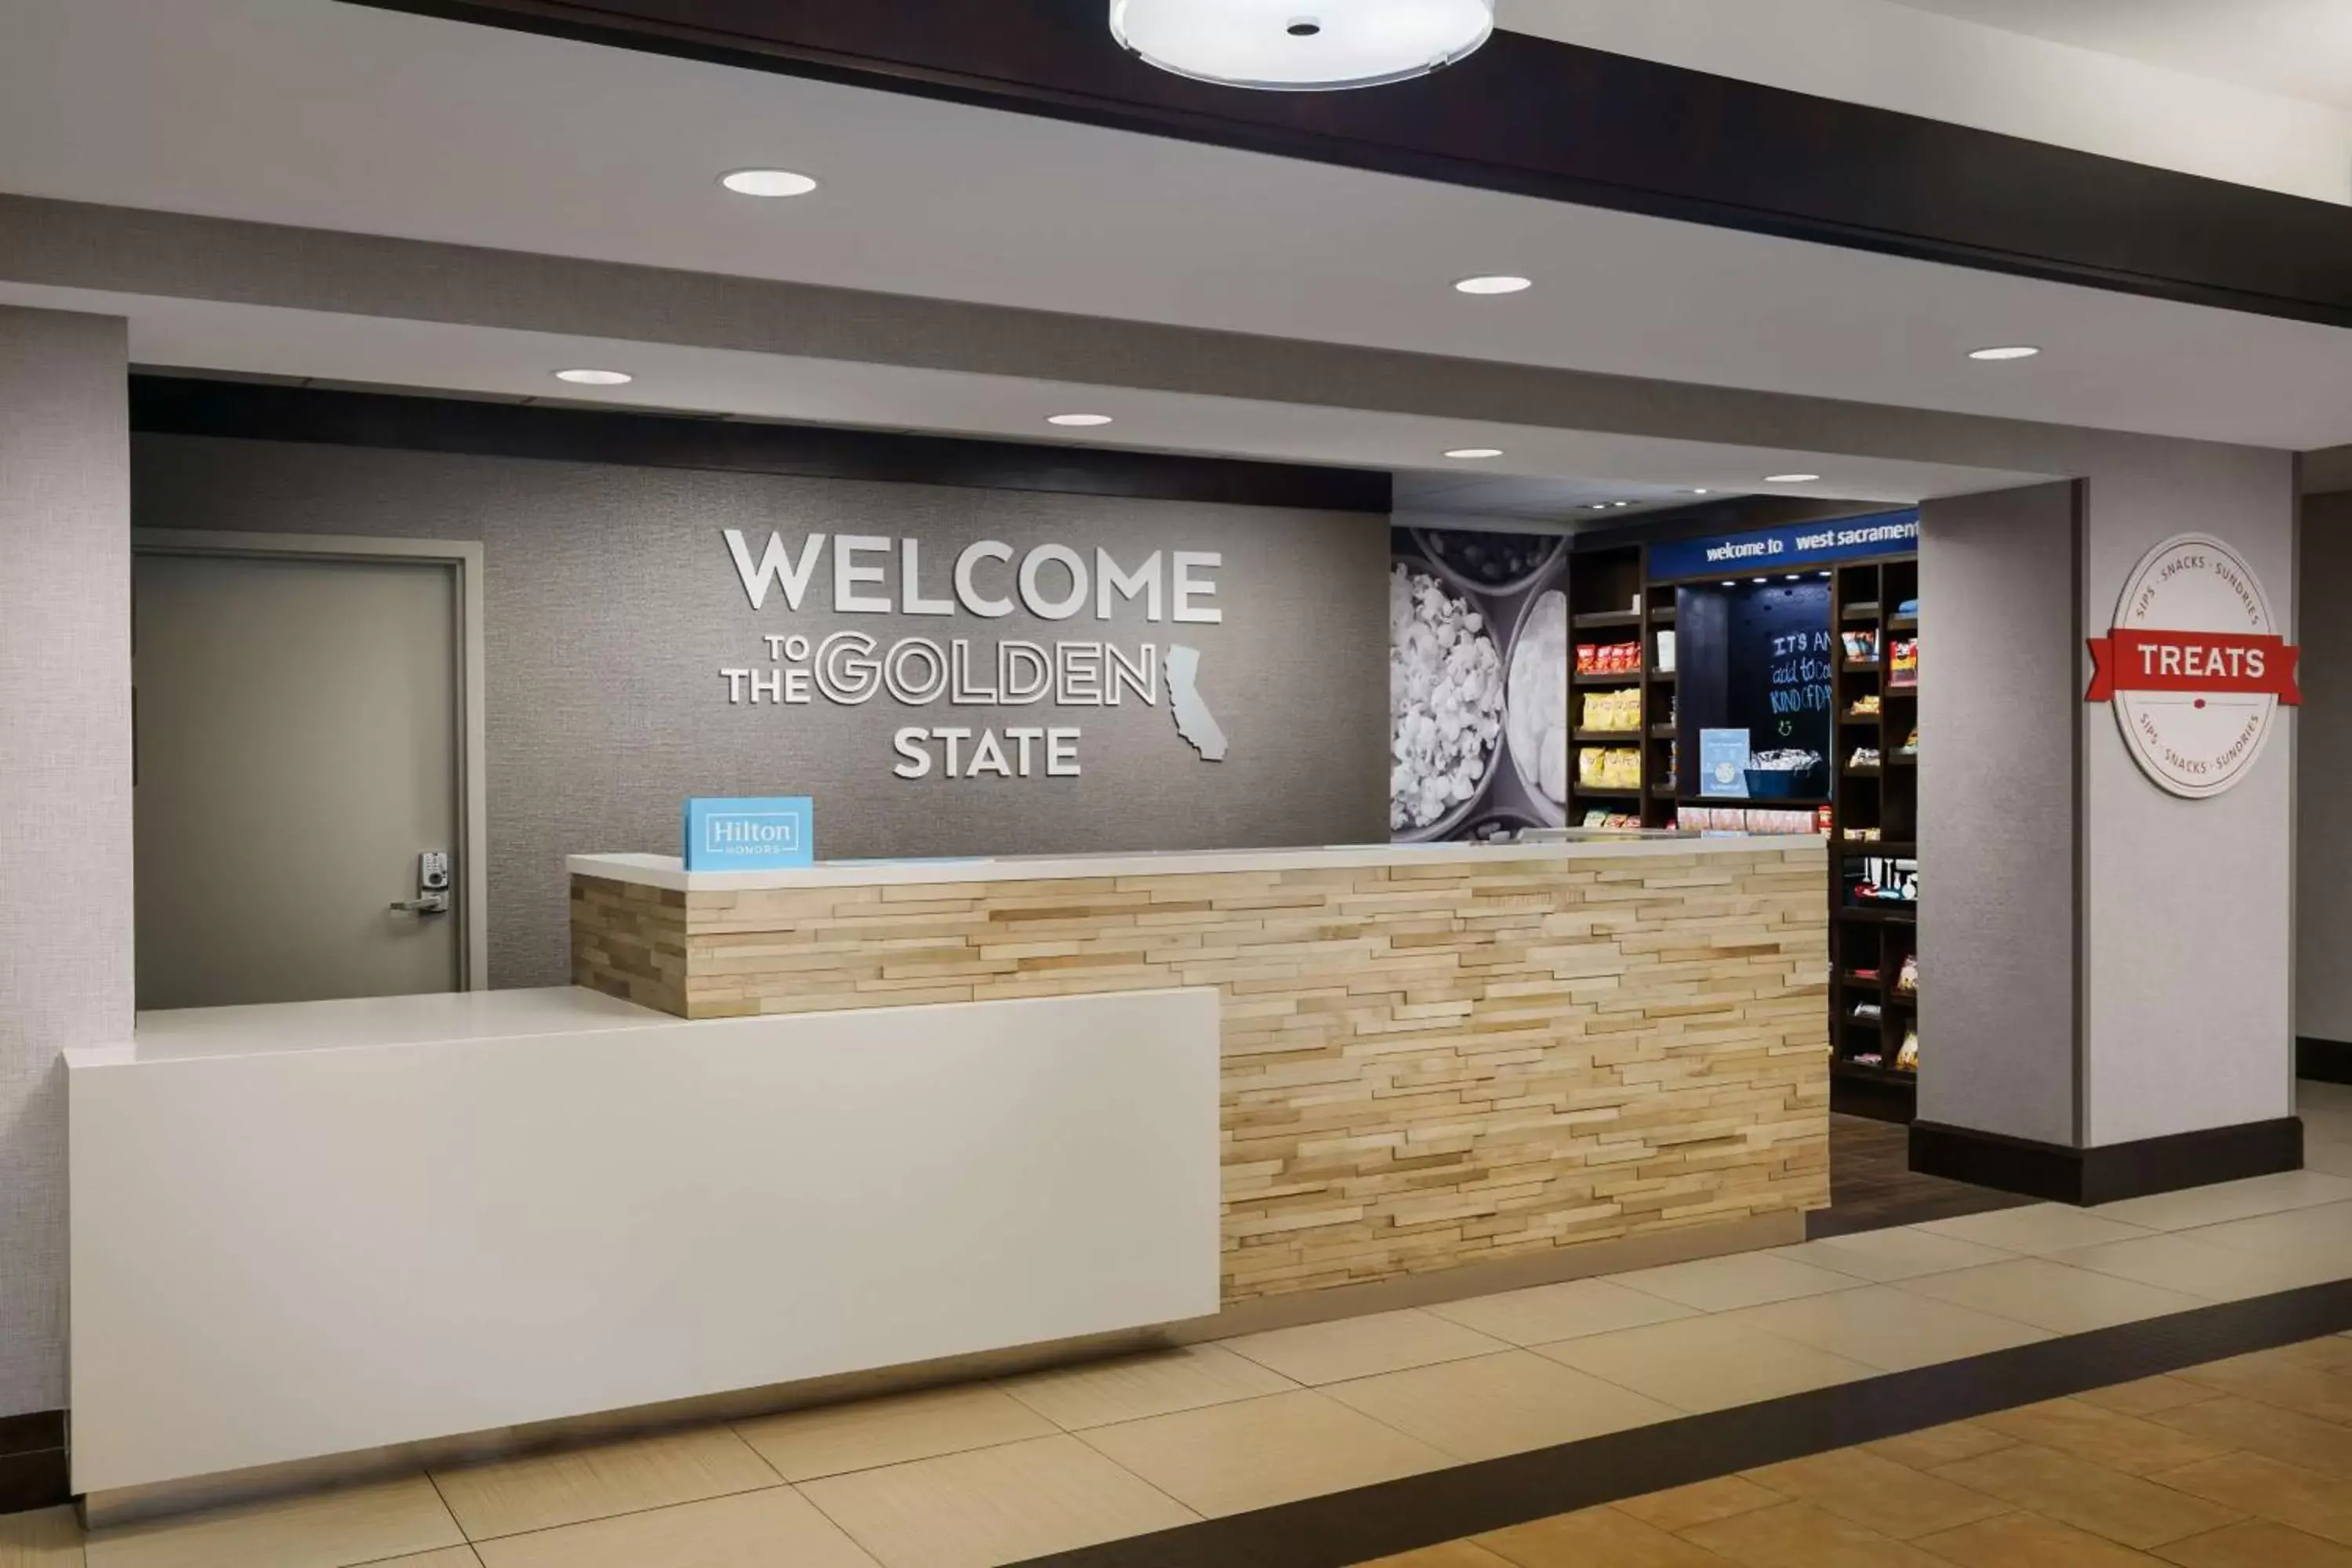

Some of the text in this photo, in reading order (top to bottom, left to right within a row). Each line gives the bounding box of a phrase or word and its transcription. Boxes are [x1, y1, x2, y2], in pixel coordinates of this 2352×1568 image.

[1706, 543, 1764, 562] welcome
[1766, 539, 1784, 554] to
[1795, 530, 1835, 550] west
[723, 529, 1222, 624] WELCOME
[2136, 556, 2259, 626] SIPS SNACKS SUNDRIES
[720, 630, 1157, 706] THE GOLDEN
[764, 634, 810, 662] TO
[2137, 644, 2265, 678] TREATS
[892, 727, 1081, 779] STATE
[2140, 713, 2259, 775] SIPS SNACKS SUNDRIES
[714, 819, 790, 842] Hilton
[725, 845, 780, 855] HONORS
